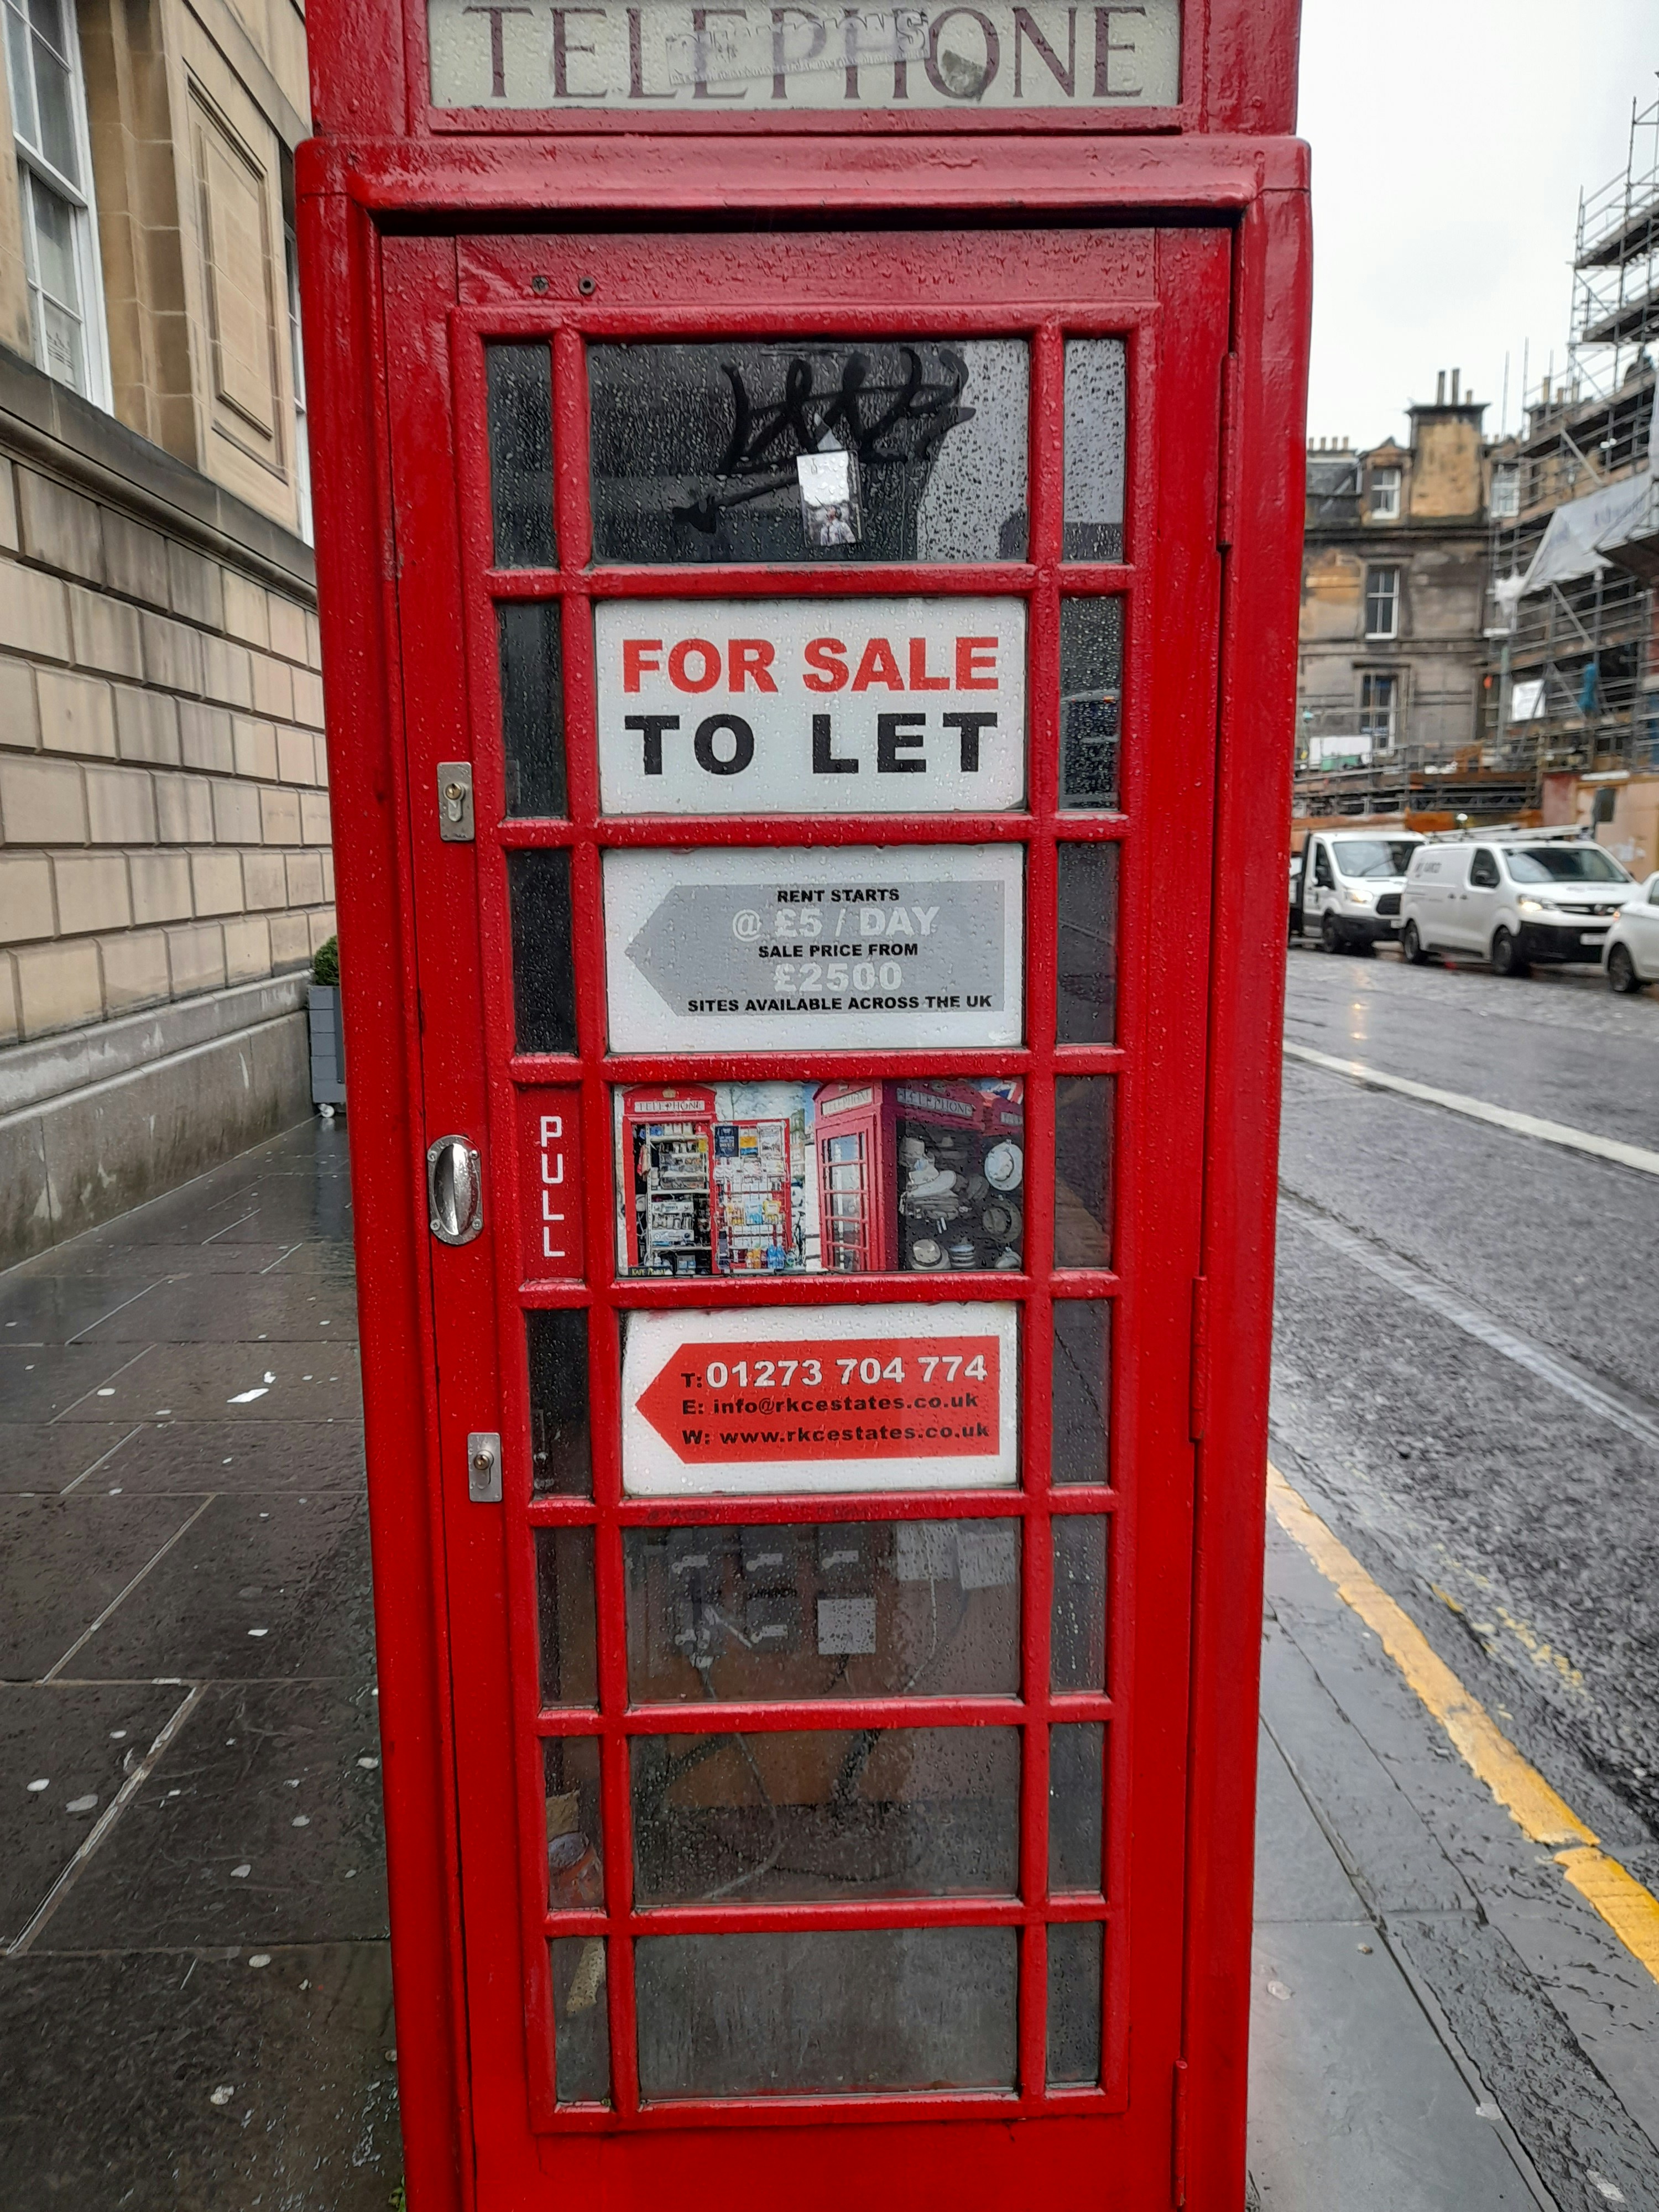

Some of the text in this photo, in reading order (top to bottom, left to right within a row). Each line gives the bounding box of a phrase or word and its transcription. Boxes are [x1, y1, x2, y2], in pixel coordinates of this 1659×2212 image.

[462, 5, 1147, 101] TELEPHONE
[623, 637, 999, 693] FOR SALE
[625, 712, 998, 775] TO LET
[777, 889, 900, 903] RENT STARTS
[732, 906, 940, 942] @ £5 / DAY
[758, 943, 918, 958] SALE PRICE FROM
[774, 962, 902, 992] £2500
[687, 995, 992, 1013] SITES AVAILABLE ACROSS THE UK
[540, 1115, 566, 1258] PULL
[836, 1357, 905, 1385] 704
[917, 1354, 988, 1383] 774
[682, 1392, 978, 1415] E: info@rkcestates.co.uk
[682, 1422, 989, 1445] W: www.rkcestates.co.uk
